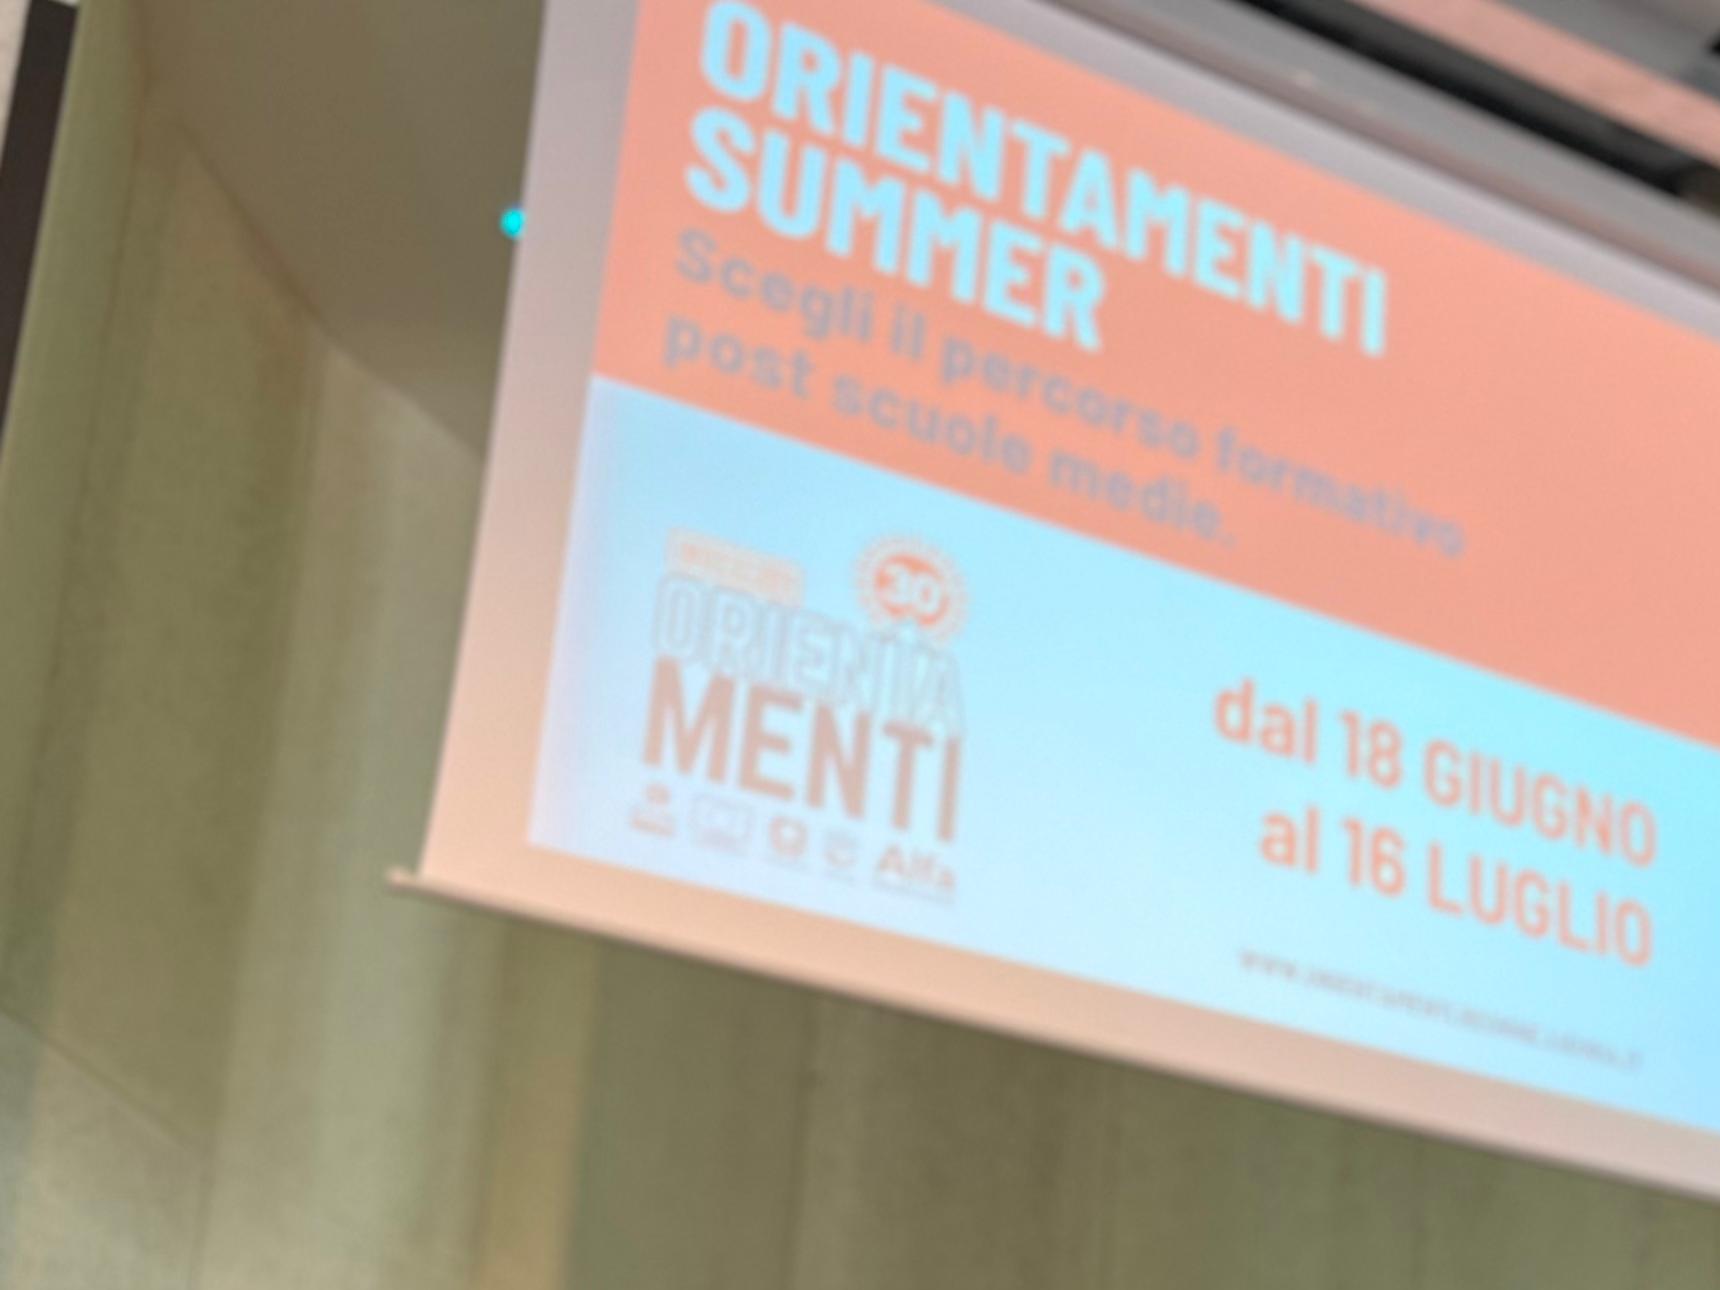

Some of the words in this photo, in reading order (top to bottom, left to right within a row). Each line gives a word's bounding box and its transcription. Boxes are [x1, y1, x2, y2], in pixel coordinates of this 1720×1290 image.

[686, 105, 1106, 351] SUMMER
[700, 0, 1388, 358] ORIENTAMENTI
[663, 312, 815, 400] post
[831, 372, 1034, 477] scuole
[1048, 445, 1237, 552] medie.
[674, 226, 875, 344] Scegli
[889, 304, 927, 364] il
[941, 332, 1200, 462] percorso
[1215, 424, 1465, 558] formativo
[641, 652, 965, 845] MENTI
[1213, 677, 1319, 765] dal
[1340, 707, 1403, 790] 18
[1423, 737, 1658, 867] GIUGNO
[1258, 804, 1321, 875] al
[1341, 814, 1407, 897] 16
[1427, 839, 1654, 968] LUGLIO
